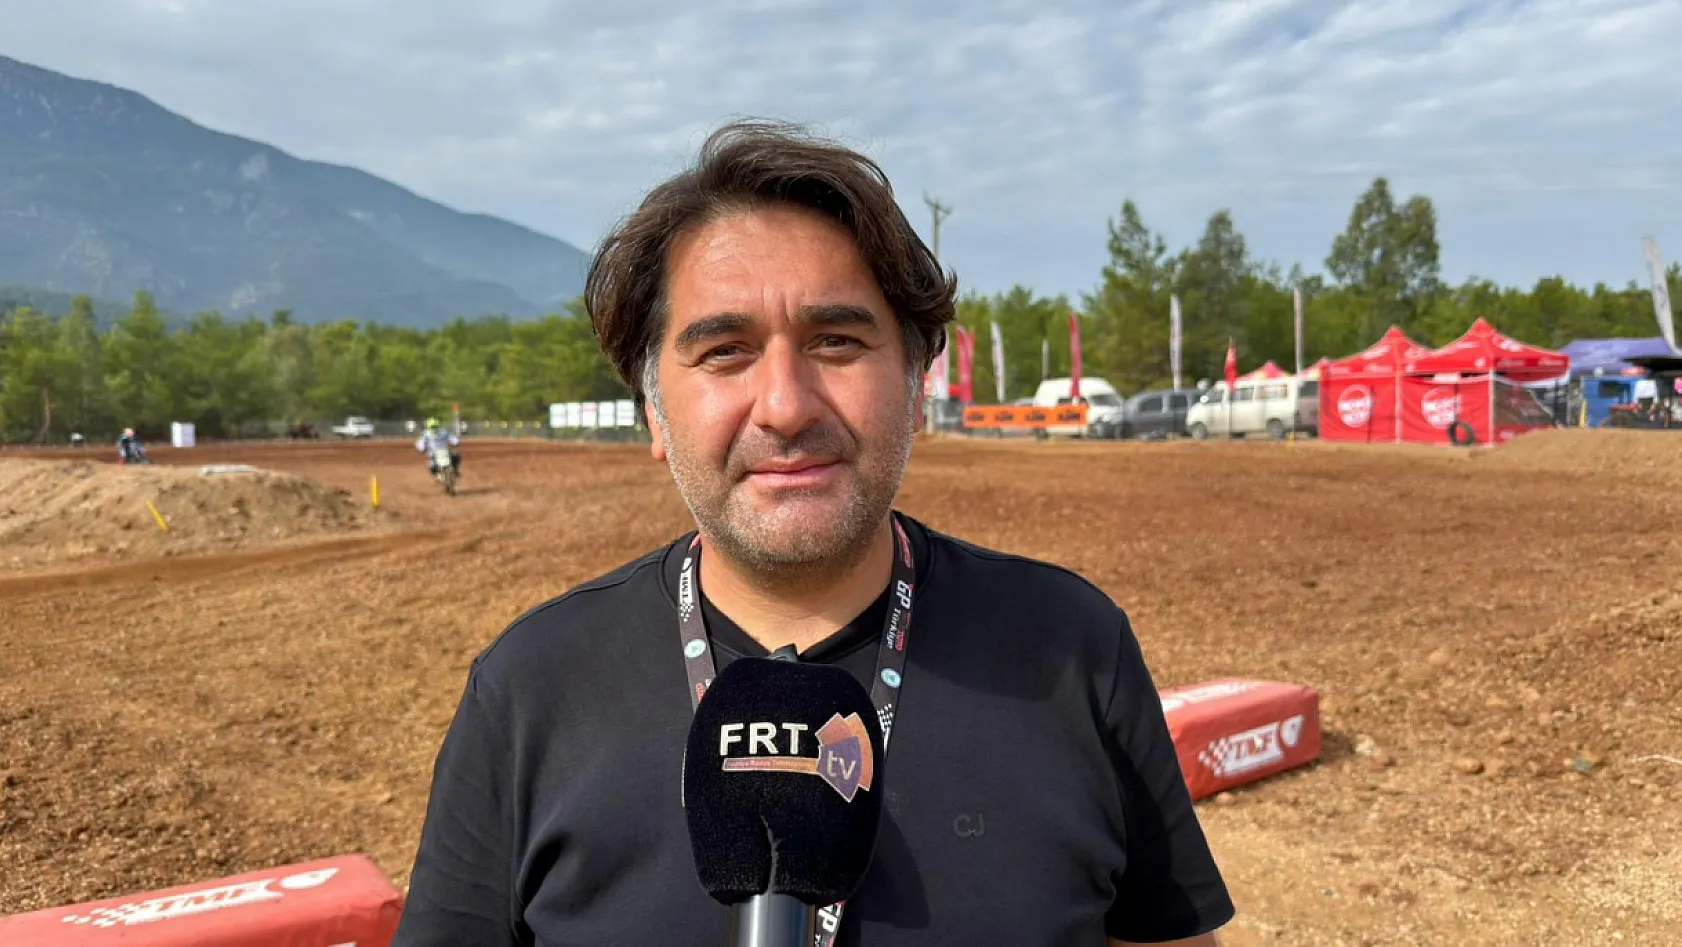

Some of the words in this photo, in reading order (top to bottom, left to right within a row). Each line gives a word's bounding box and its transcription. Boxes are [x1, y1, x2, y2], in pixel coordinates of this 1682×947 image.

[896, 579, 912, 609] GP
[720, 722, 808, 755] FRT
[826, 750, 858, 781] tv
